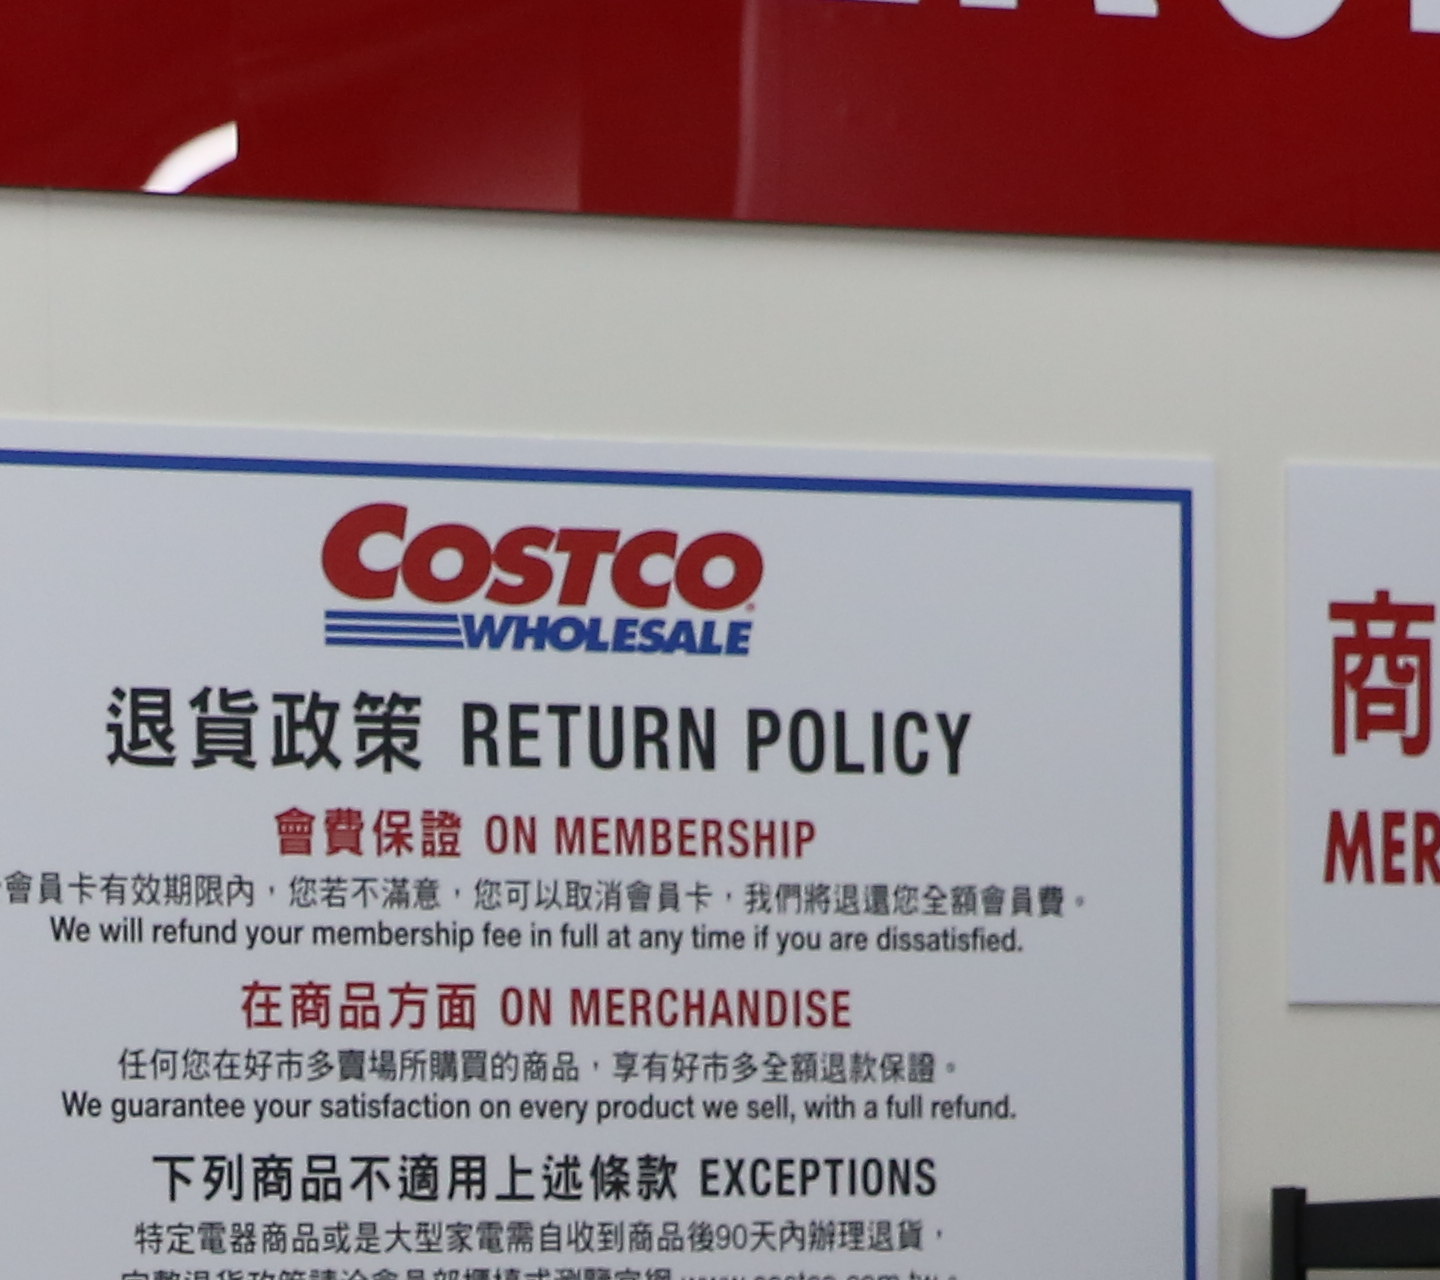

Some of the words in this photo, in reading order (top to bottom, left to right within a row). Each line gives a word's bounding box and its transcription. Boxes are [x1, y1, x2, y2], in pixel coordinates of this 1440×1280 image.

[320, 502, 764, 613] COSTCO
[461, 613, 753, 657] WHOLESALE
[105, 685, 422, 774] 退貨政策
[462, 701, 716, 772] RETURN
[747, 707, 972, 776] POLICY
[274, 806, 462, 858] 會費保證
[485, 814, 537, 855] ON
[555, 815, 816, 859] MEMBERSHIP
[49, 915, 91, 943] We
[99, 916, 143, 944] will
[152, 917, 237, 945] refund
[245, 924, 305, 951] your
[312, 919, 475, 953] membership
[481, 920, 522, 948] fee
[530, 921, 553, 948] in
[559, 922, 599, 949] full
[606, 924, 631, 949] at
[638, 928, 684, 956] any
[690, 923, 746, 950] time
[754, 924, 770, 951] if
[775, 930, 822, 957] you
[829, 931, 869, 952] are
[876, 925, 1023, 953] dissatisfied.
[241, 979, 477, 1031] 在商品方面
[500, 985, 552, 1027] ON
[570, 987, 852, 1029] MERCHANDISE
[61, 1090, 103, 1118] We
[110, 1092, 246, 1124] guarantee
[253, 1098, 313, 1125] your
[320, 1091, 471, 1120] satisfaction
[479, 1099, 511, 1120] on
[519, 1098, 589, 1125] every
[596, 1092, 696, 1125] product
[702, 1099, 739, 1120] we
[746, 1093, 796, 1124] sell,
[803, 1093, 856, 1120] with
[863, 1099, 879, 1120] a
[885, 1093, 923, 1120] full
[930, 1093, 1017, 1120] refund.
[152, 1152, 678, 1203] 下列商品不適用上述條款
[700, 1157, 937, 1198] EXCEPTIONS
